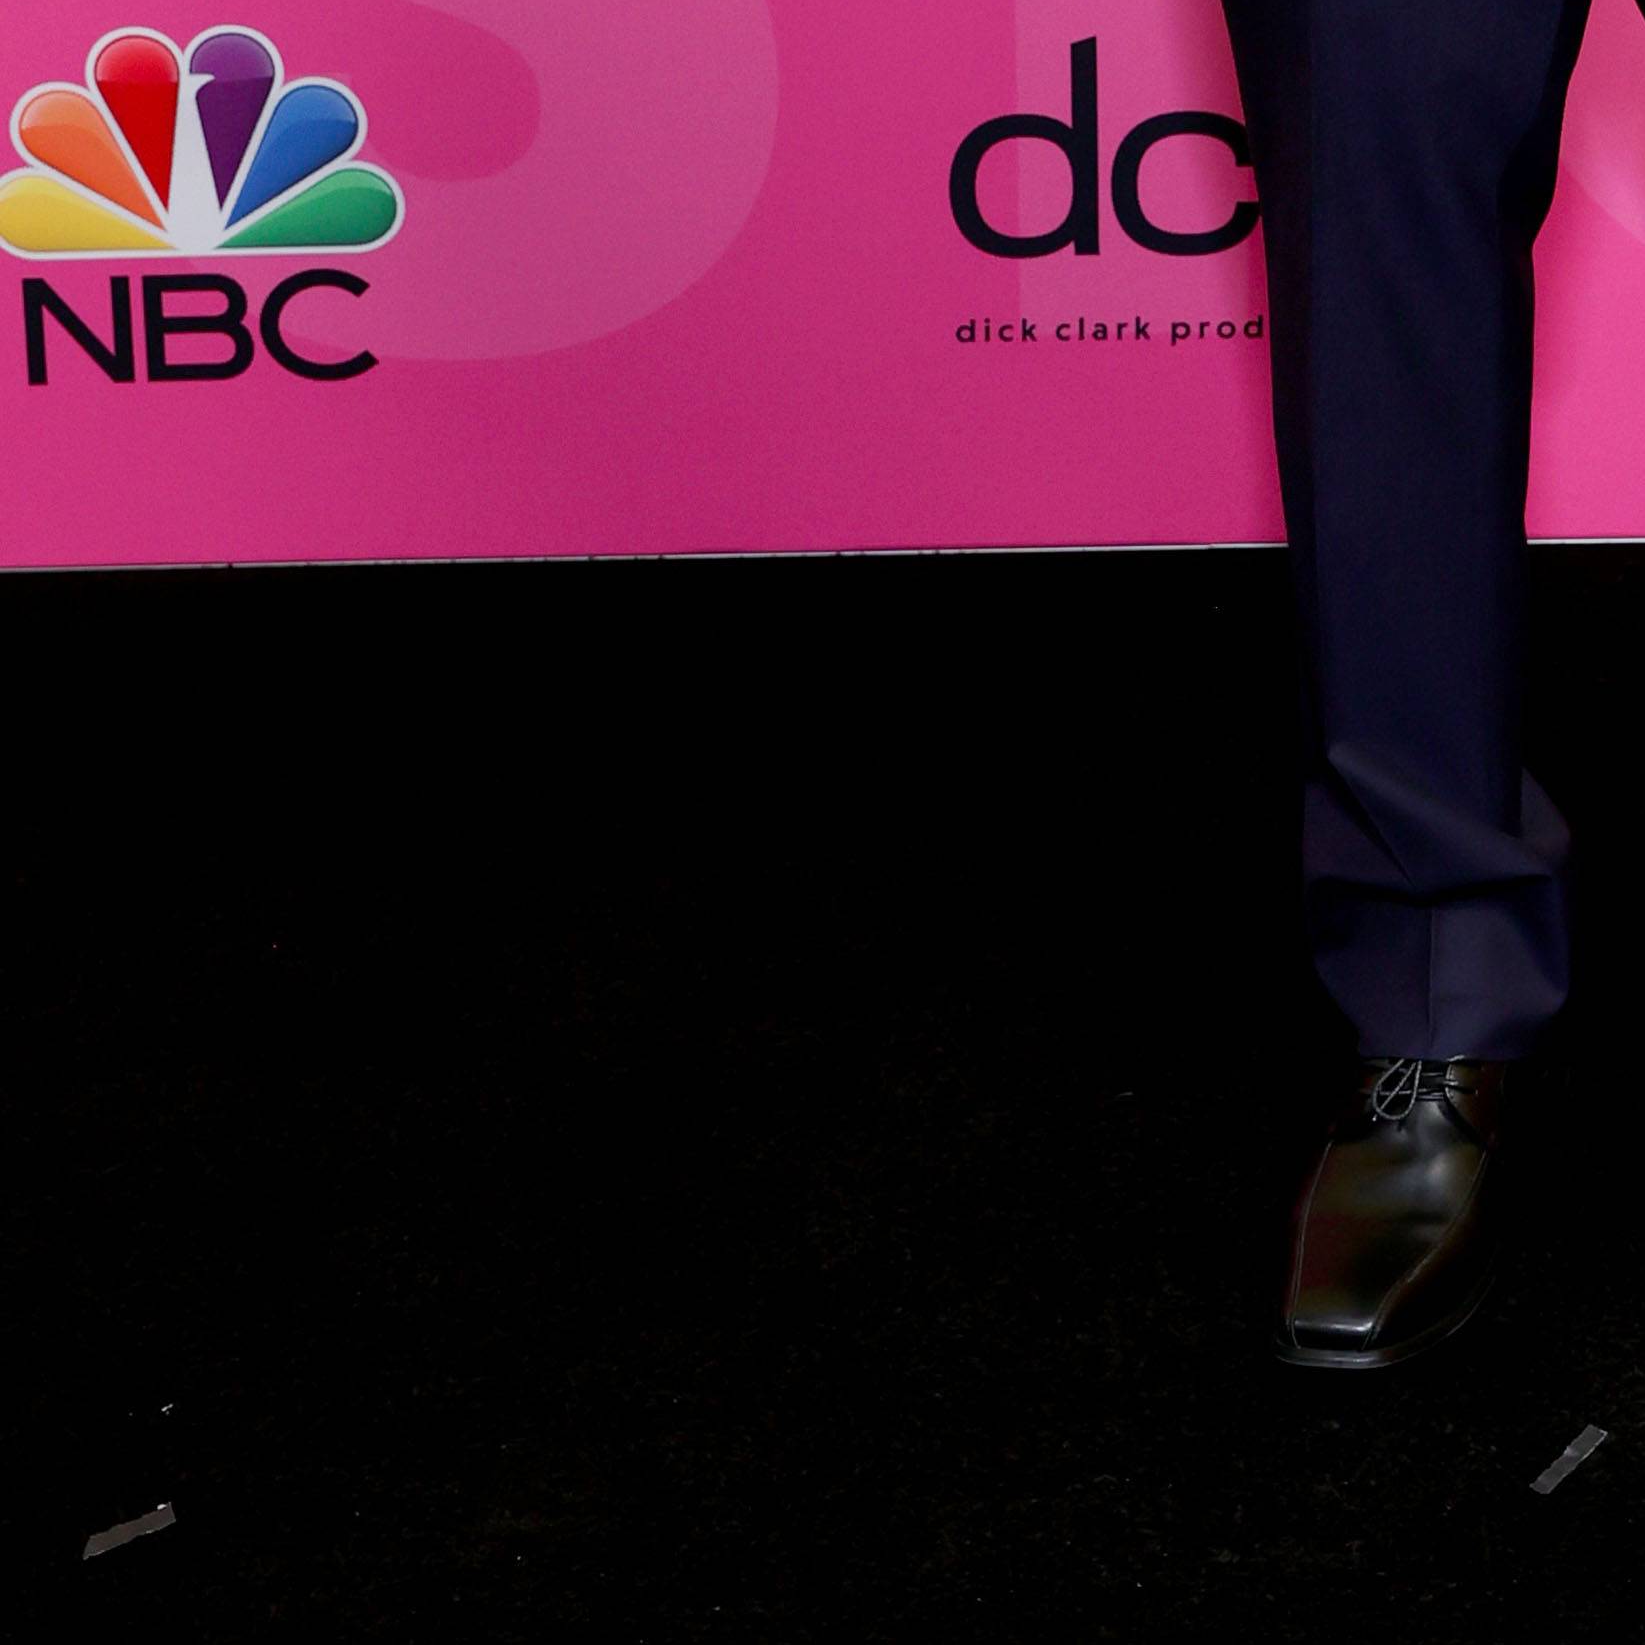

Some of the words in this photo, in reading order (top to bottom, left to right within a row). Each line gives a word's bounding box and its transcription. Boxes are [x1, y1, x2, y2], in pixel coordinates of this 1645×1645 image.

[23, 270, 379, 386] NBC
[957, 319, 1037, 343] dick
[1057, 318, 1150, 342] clark
